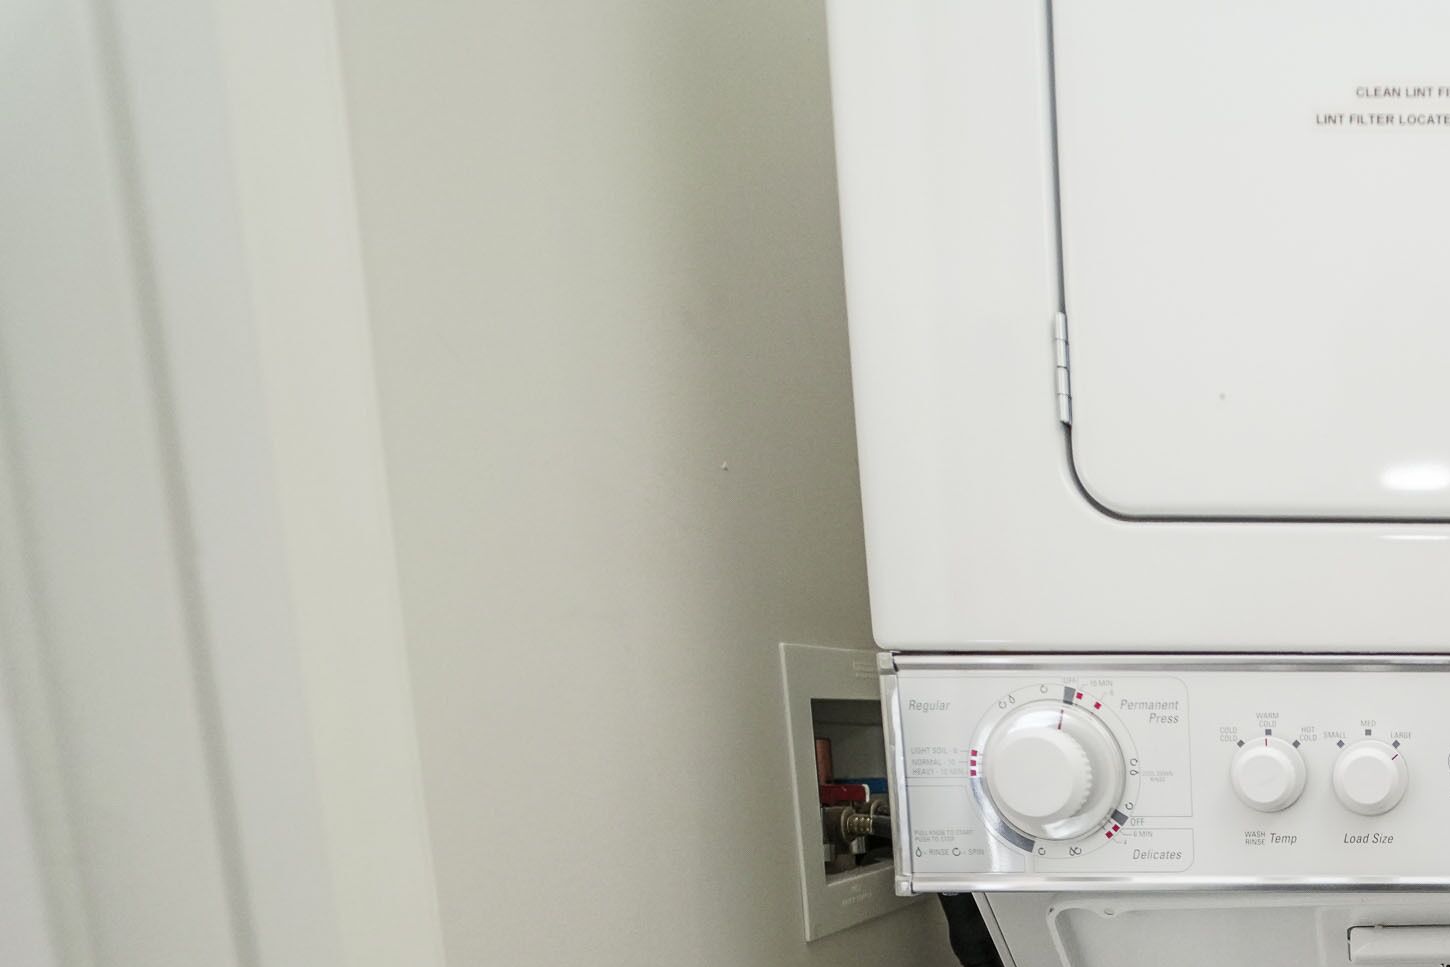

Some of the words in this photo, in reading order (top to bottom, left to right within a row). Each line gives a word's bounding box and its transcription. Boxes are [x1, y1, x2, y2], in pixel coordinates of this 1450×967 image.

[1356, 86, 1401, 98] CLEAN
[1405, 86, 1433, 98] LINT
[1316, 114, 1344, 126] LINT
[1349, 114, 1395, 126] FILTER
[909, 700, 950, 712] Regular
[1120, 700, 1179, 711] Permanent
[1149, 714, 1179, 724] Press
[1259, 720, 1277, 728] COLD
[1361, 720, 1376, 728] MED
[1300, 734, 1317, 742] COLD
[1323, 731, 1347, 739] SMALL
[1390, 731, 1412, 739] LARGE
[1130, 818, 1144, 826] OFF
[1245, 838, 1265, 846] RINSE
[1270, 833, 1297, 846] Temp
[1344, 833, 1370, 845] Load
[1372, 833, 1393, 845] Size
[1133, 849, 1182, 860] Delicates
